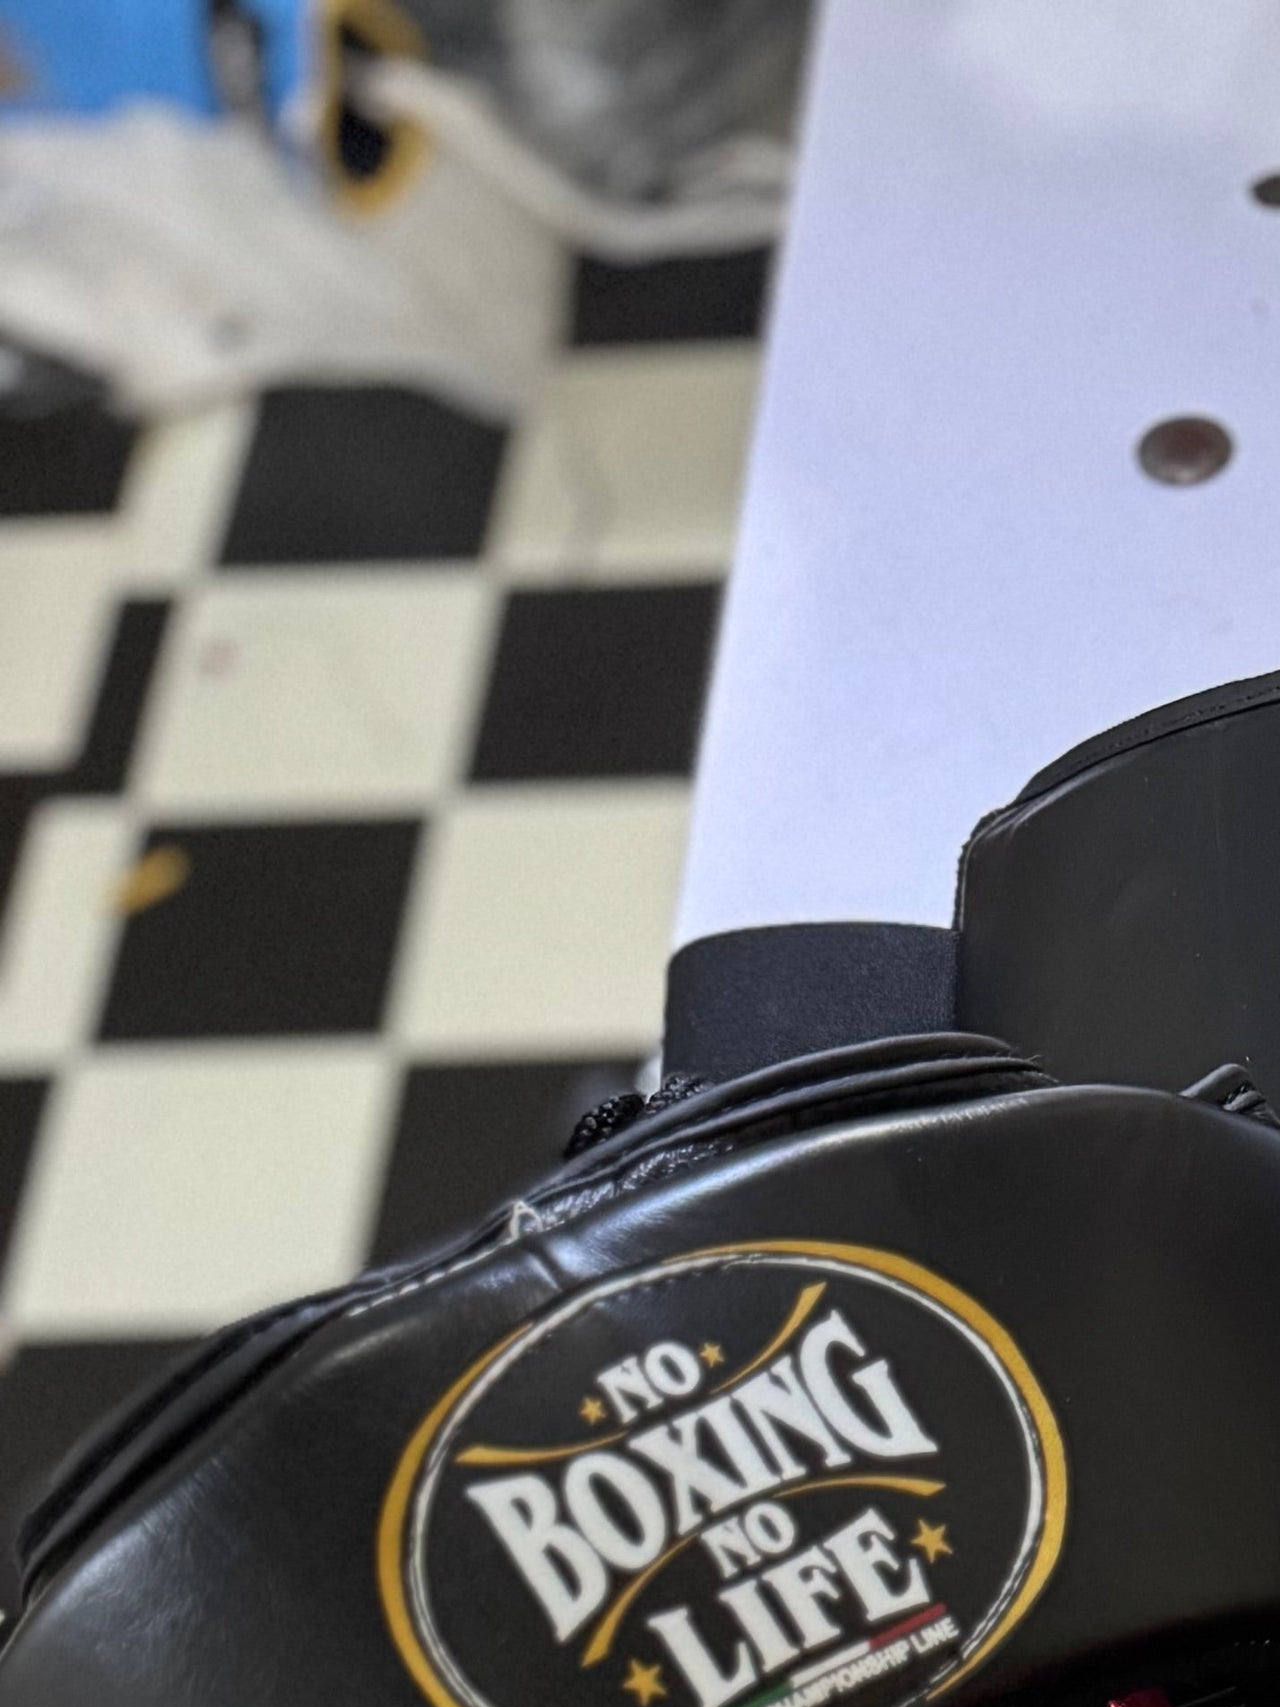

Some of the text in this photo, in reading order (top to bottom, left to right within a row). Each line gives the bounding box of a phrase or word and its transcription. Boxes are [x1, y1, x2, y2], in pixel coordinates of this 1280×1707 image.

[597, 1341, 701, 1425] NO
[466, 1309, 938, 1643] BOXING
[700, 1502, 795, 1579] NO
[910, 1616, 959, 1654] LINE
